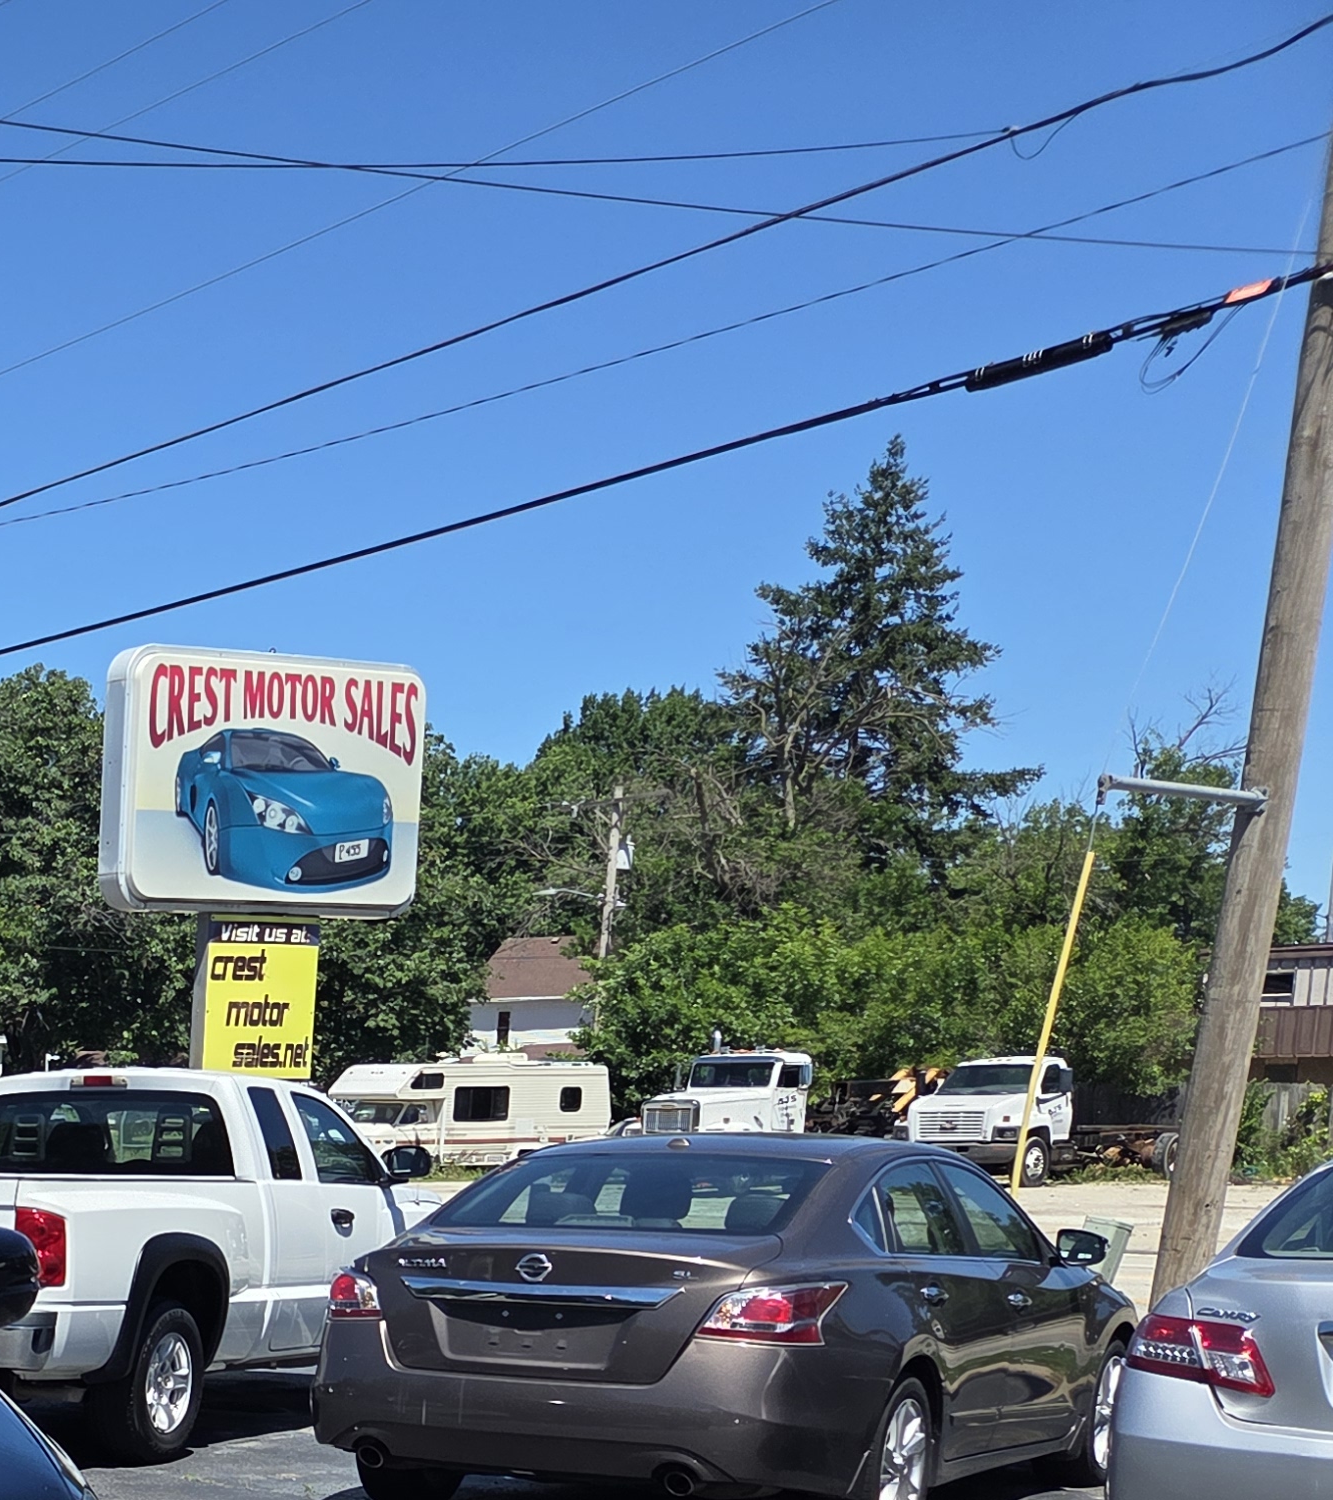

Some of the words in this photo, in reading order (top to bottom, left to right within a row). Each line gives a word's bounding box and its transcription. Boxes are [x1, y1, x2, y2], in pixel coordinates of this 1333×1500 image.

[149, 663, 238, 749] CREST
[243, 669, 337, 728] MOTOR
[343, 677, 419, 767] SALES
[220, 923, 261, 942] Visit
[264, 927, 288, 942] us
[290, 926, 311, 943] at:
[210, 949, 267, 982] crest
[225, 994, 290, 1028] motor
[231, 1035, 310, 1069] sales.net
